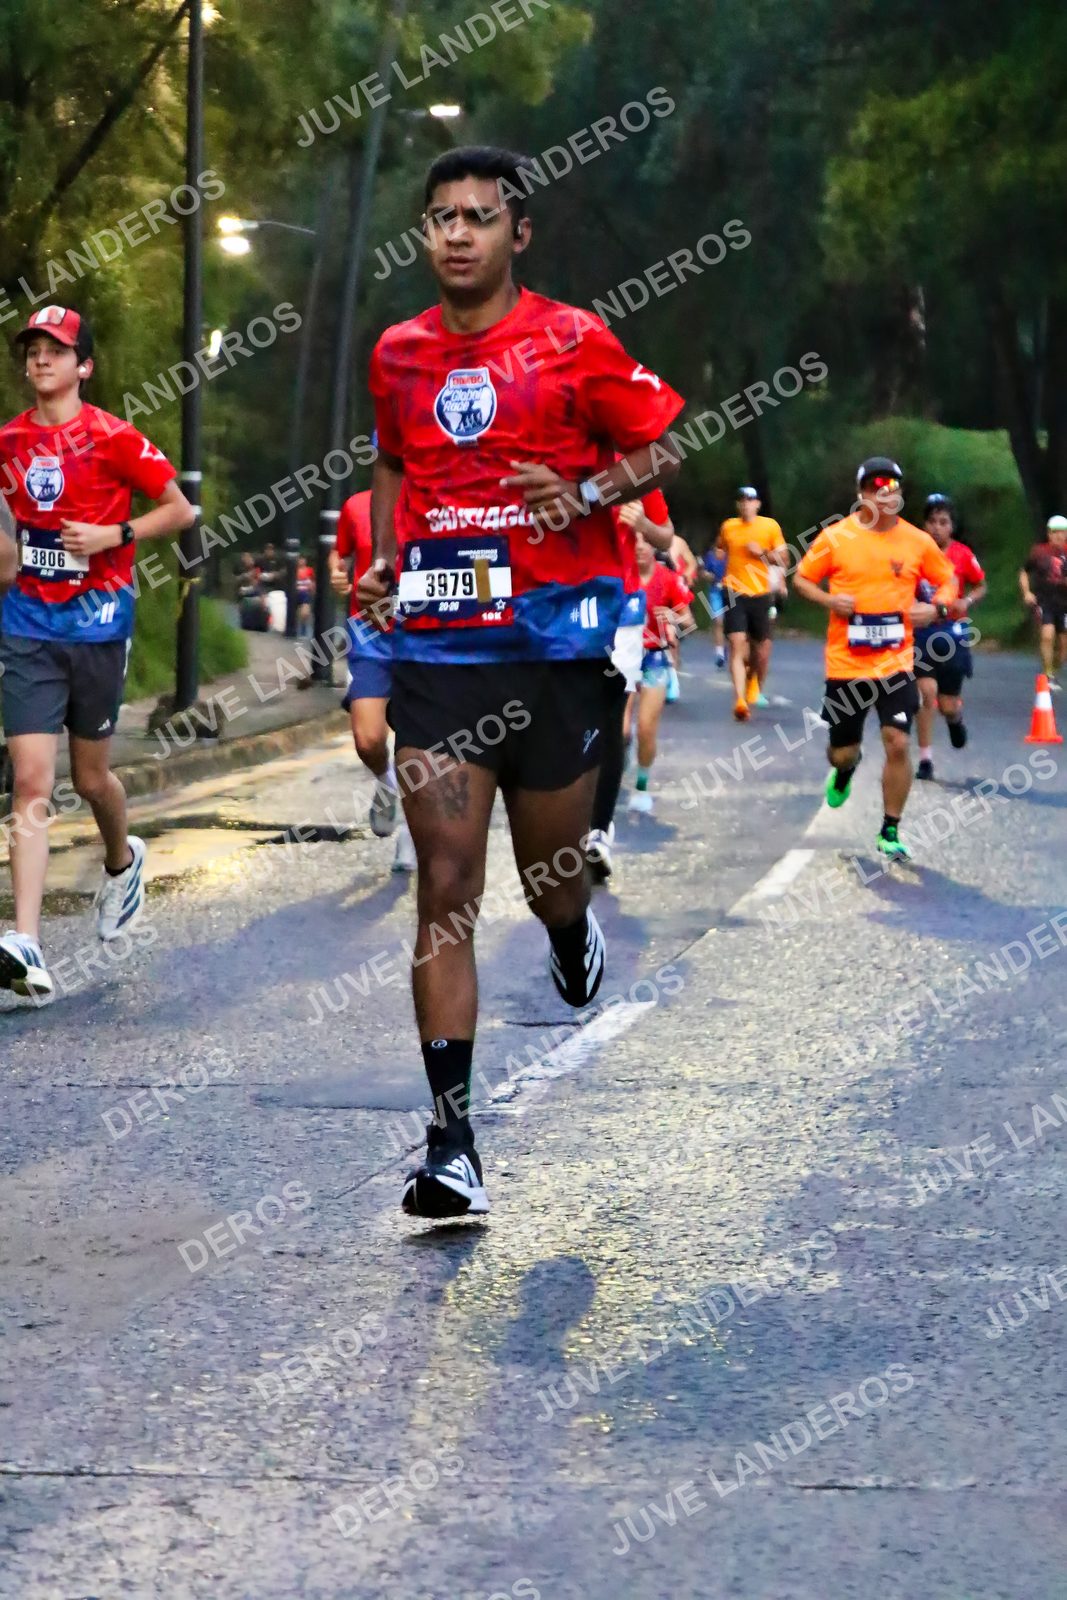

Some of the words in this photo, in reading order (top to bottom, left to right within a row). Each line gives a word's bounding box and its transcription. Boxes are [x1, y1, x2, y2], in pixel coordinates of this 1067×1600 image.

[32, 548, 65, 568] 3806
[426, 572, 474, 597] 3979
[481, 612, 502, 621] 10K
